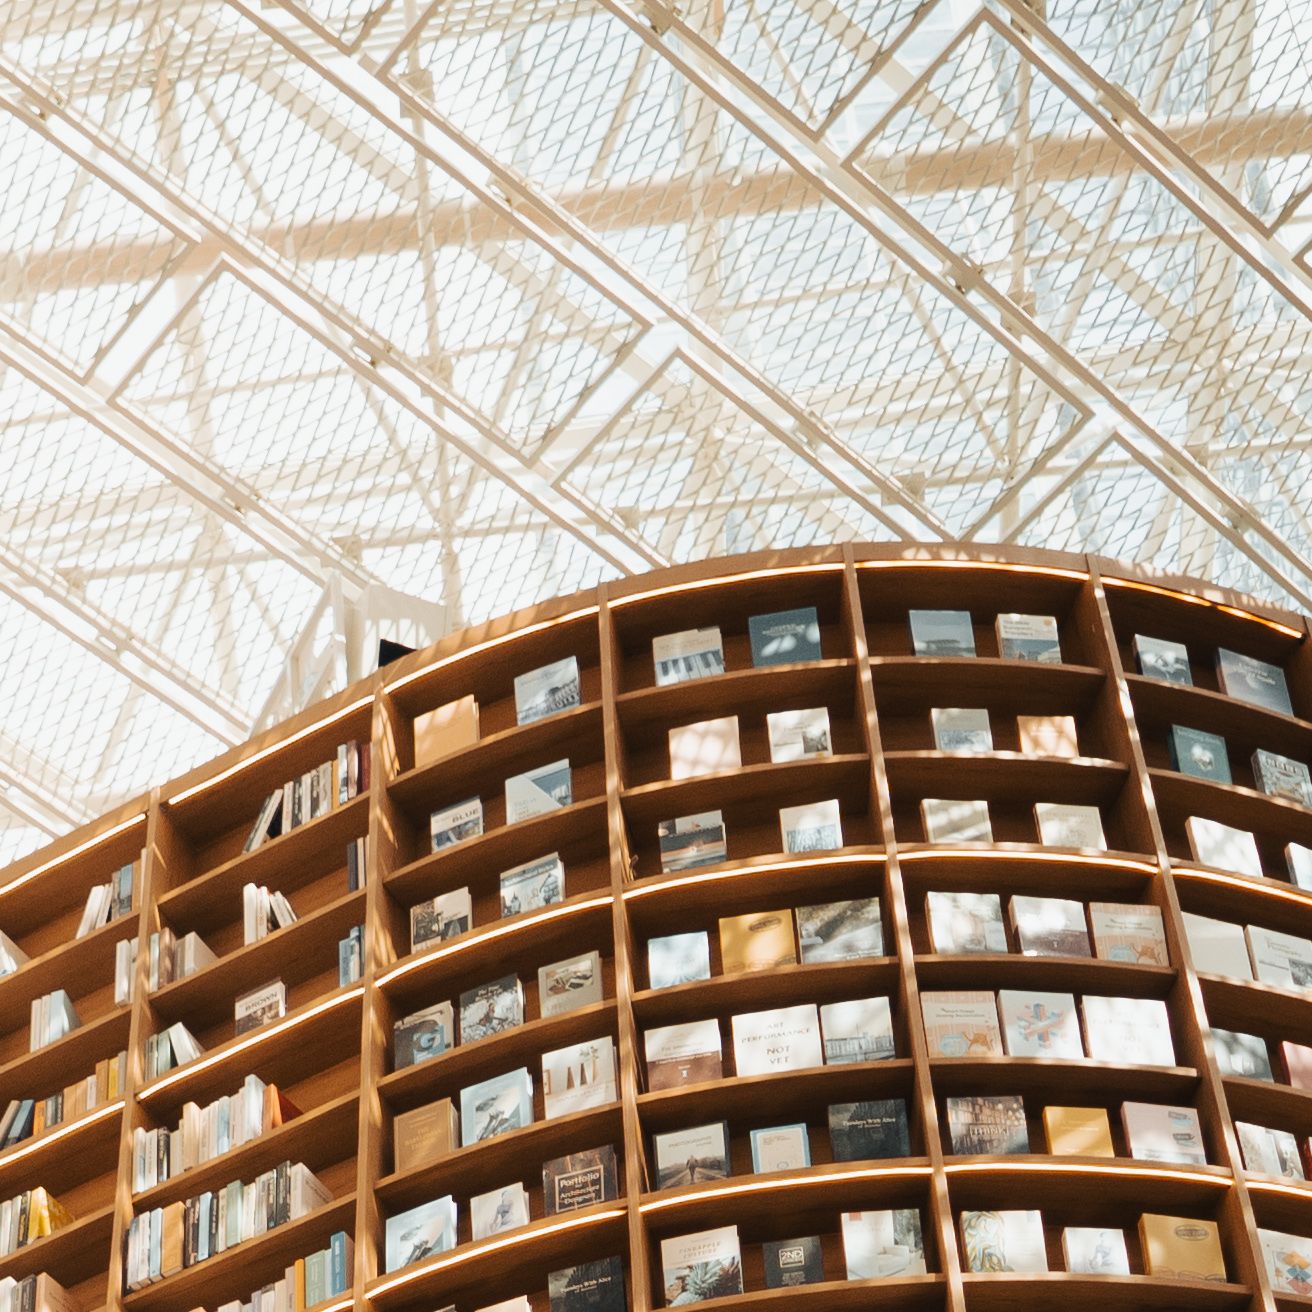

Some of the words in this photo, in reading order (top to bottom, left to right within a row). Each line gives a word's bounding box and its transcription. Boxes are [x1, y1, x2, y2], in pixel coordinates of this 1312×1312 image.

[767, 1046, 790, 1055] NOT
[769, 1056, 790, 1065] YET
[560, 1173, 599, 1188] Portfolio
